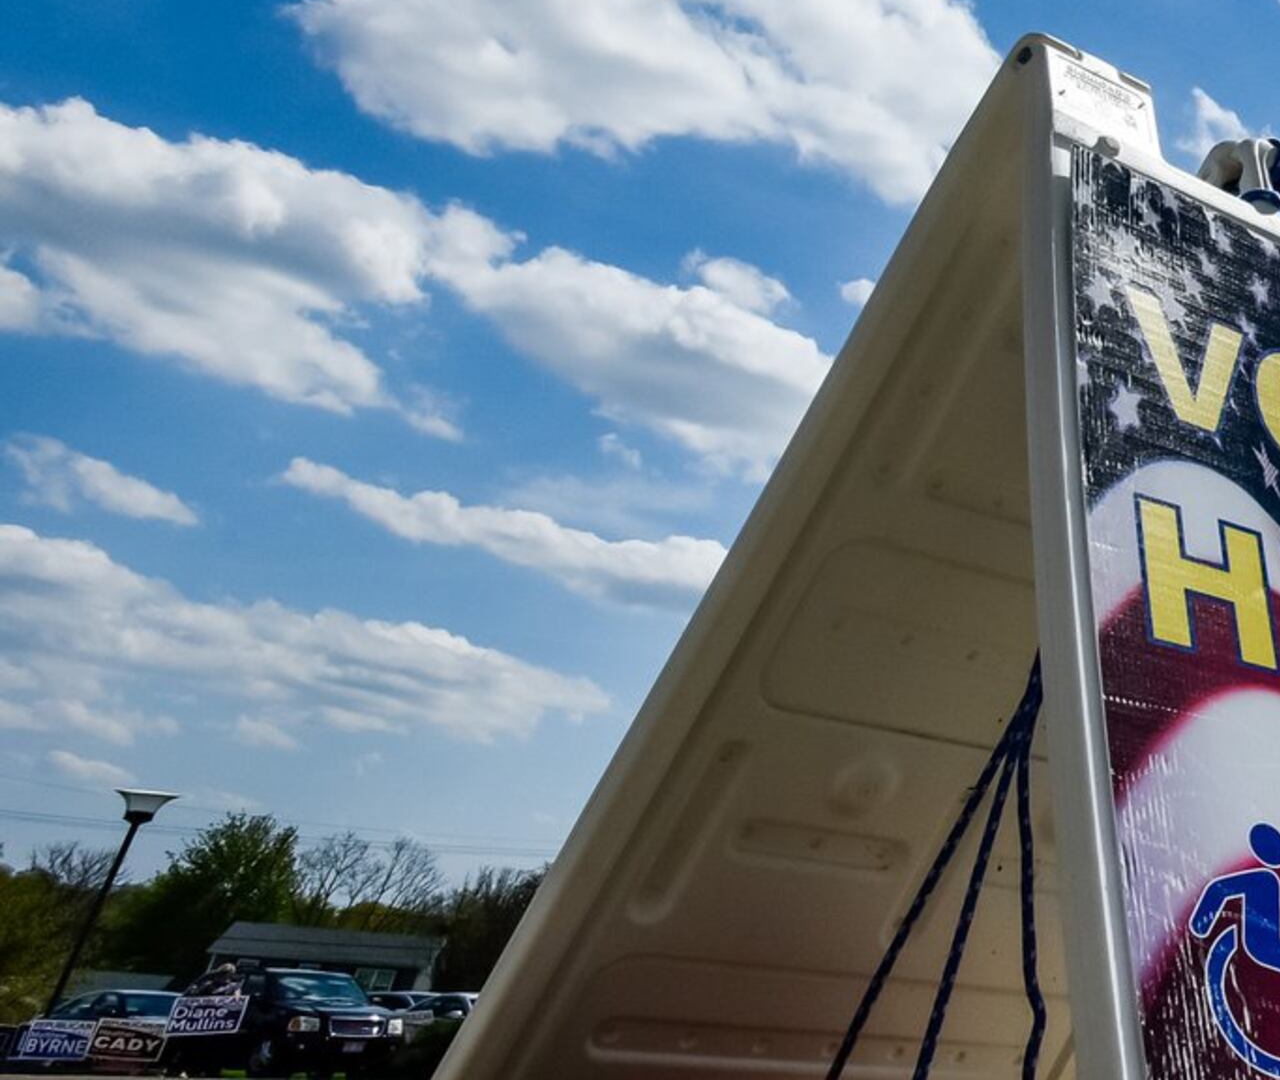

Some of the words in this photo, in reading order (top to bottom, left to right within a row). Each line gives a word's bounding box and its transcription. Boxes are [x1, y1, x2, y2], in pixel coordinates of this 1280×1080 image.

[174, 1006, 228, 1019] Diane
[168, 1018, 235, 1031] Mullins
[26, 1038, 88, 1055] BYRNE
[94, 1036, 161, 1052] CADY
